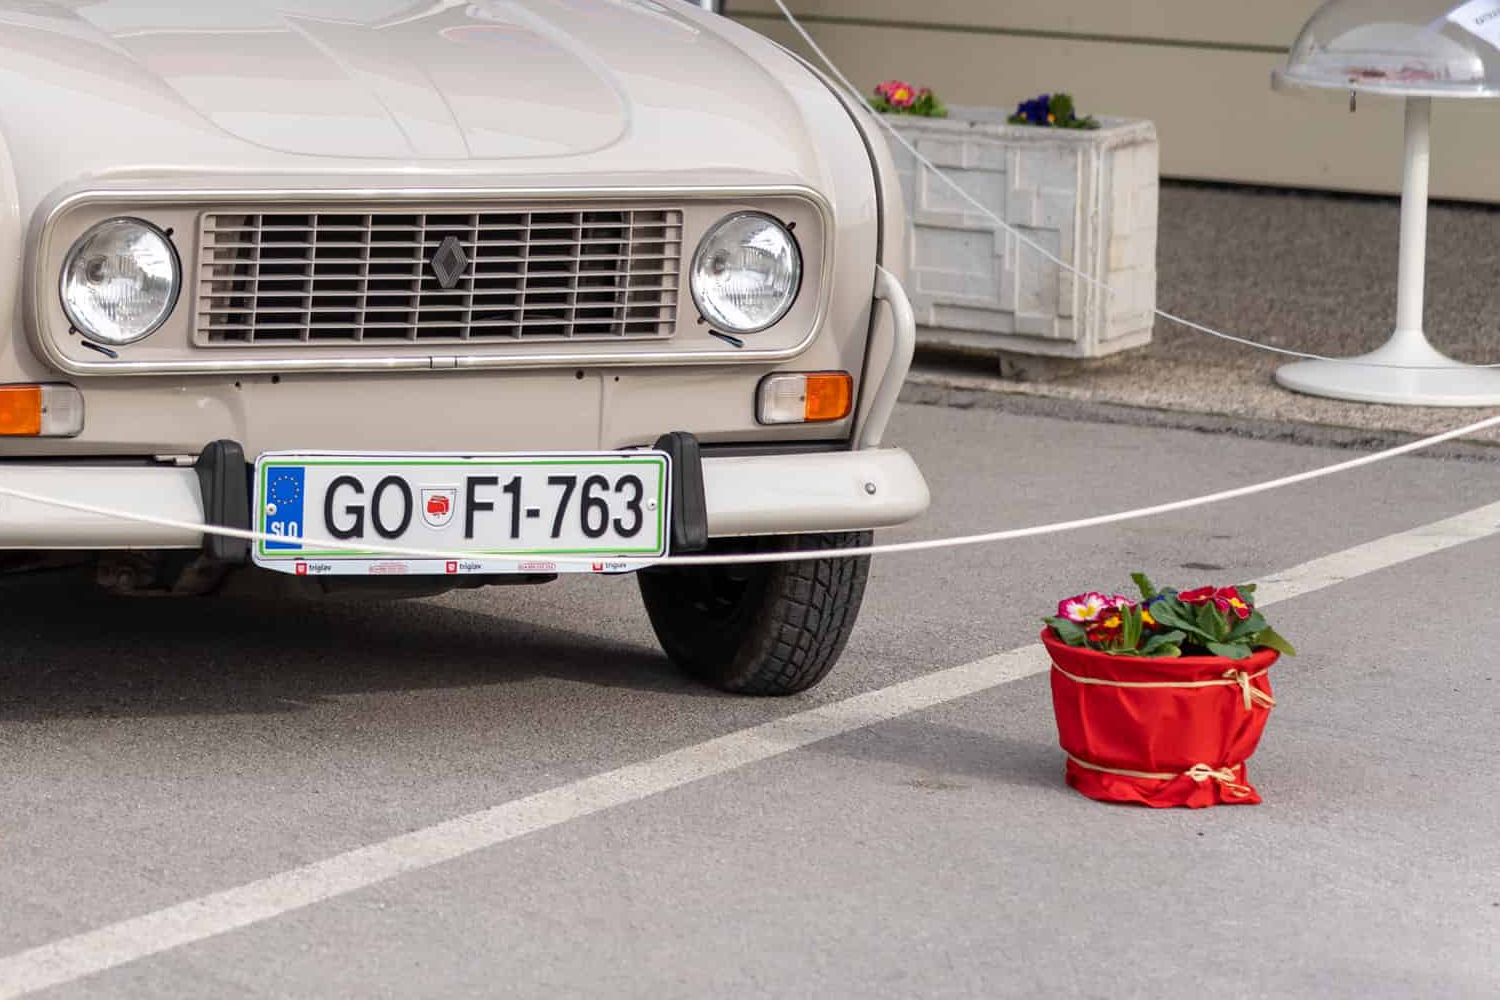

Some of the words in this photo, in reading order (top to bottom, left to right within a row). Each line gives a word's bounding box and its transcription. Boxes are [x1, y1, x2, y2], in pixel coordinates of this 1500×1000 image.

[323, 474, 414, 541] GO
[463, 474, 645, 540] F1-763
[270, 521, 299, 539] SLO
